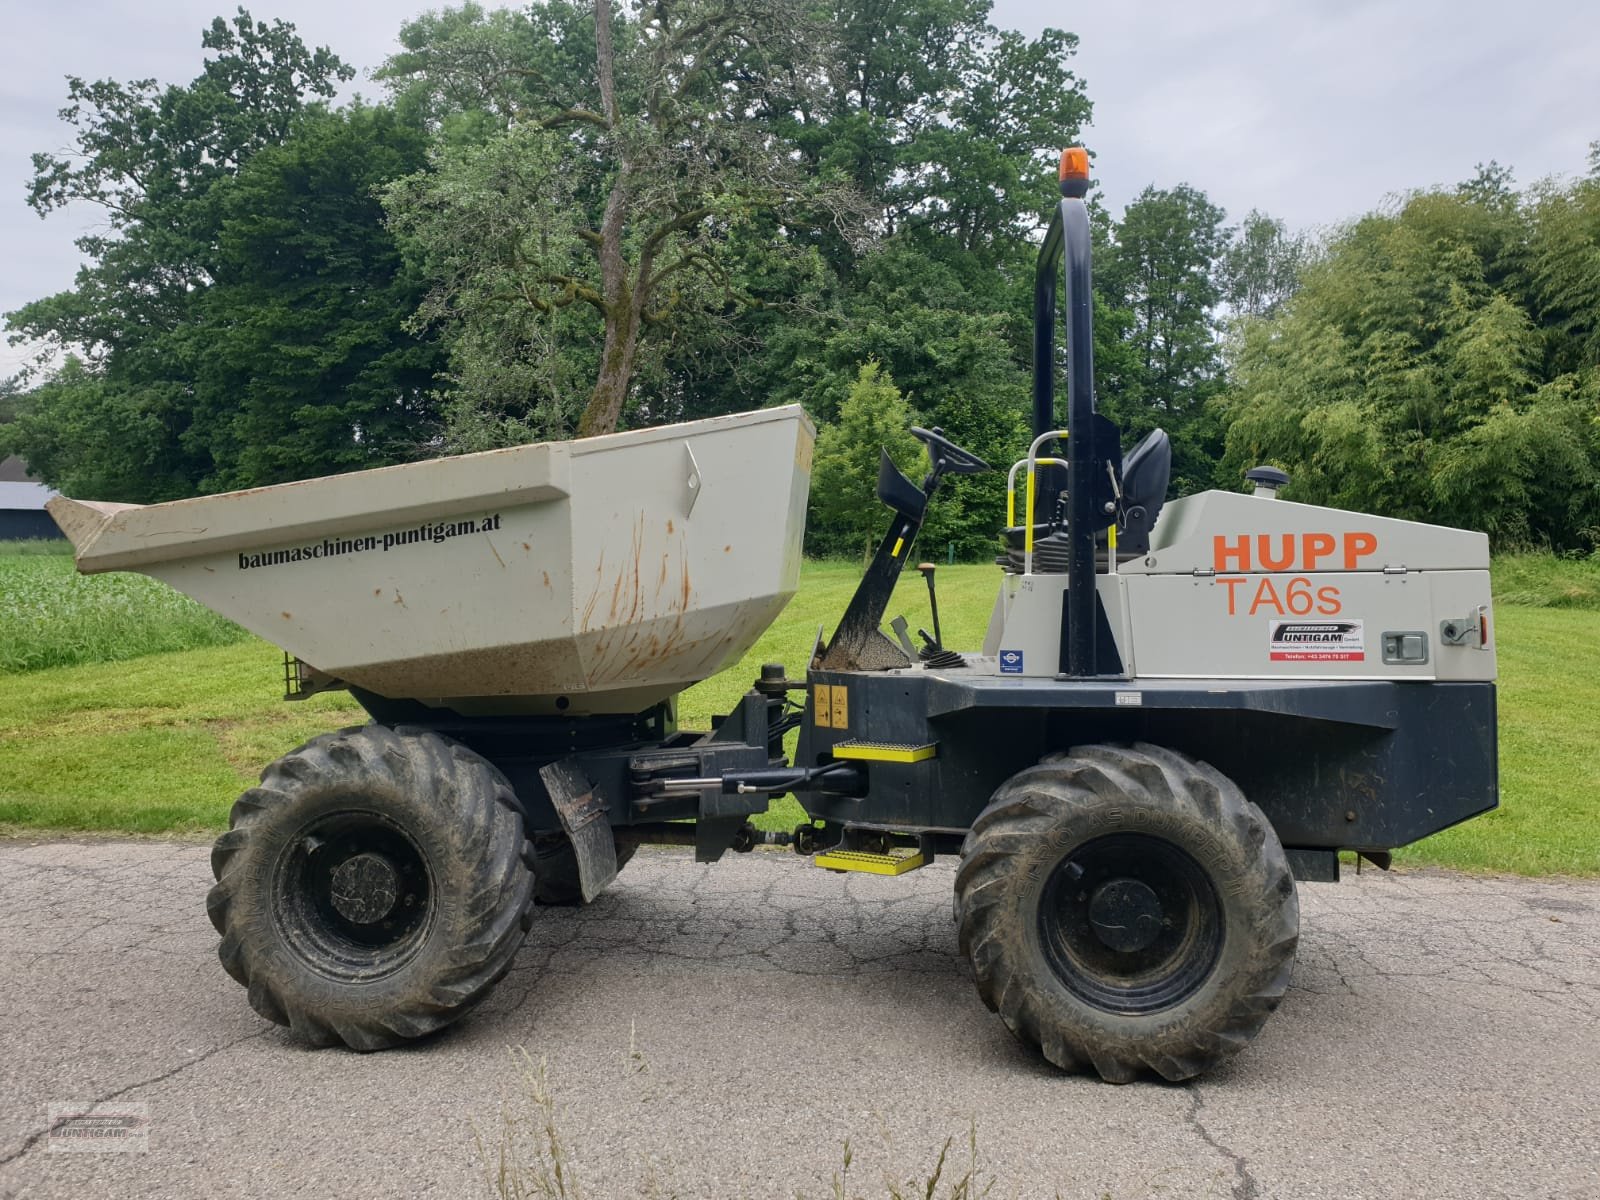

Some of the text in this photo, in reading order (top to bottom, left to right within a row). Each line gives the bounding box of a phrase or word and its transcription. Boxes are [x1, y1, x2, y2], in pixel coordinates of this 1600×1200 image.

[238, 513, 502, 570] baumaschinen-puntigam.at
[1213, 532, 1378, 572] HUPP
[1215, 577, 1342, 616] TA6s
